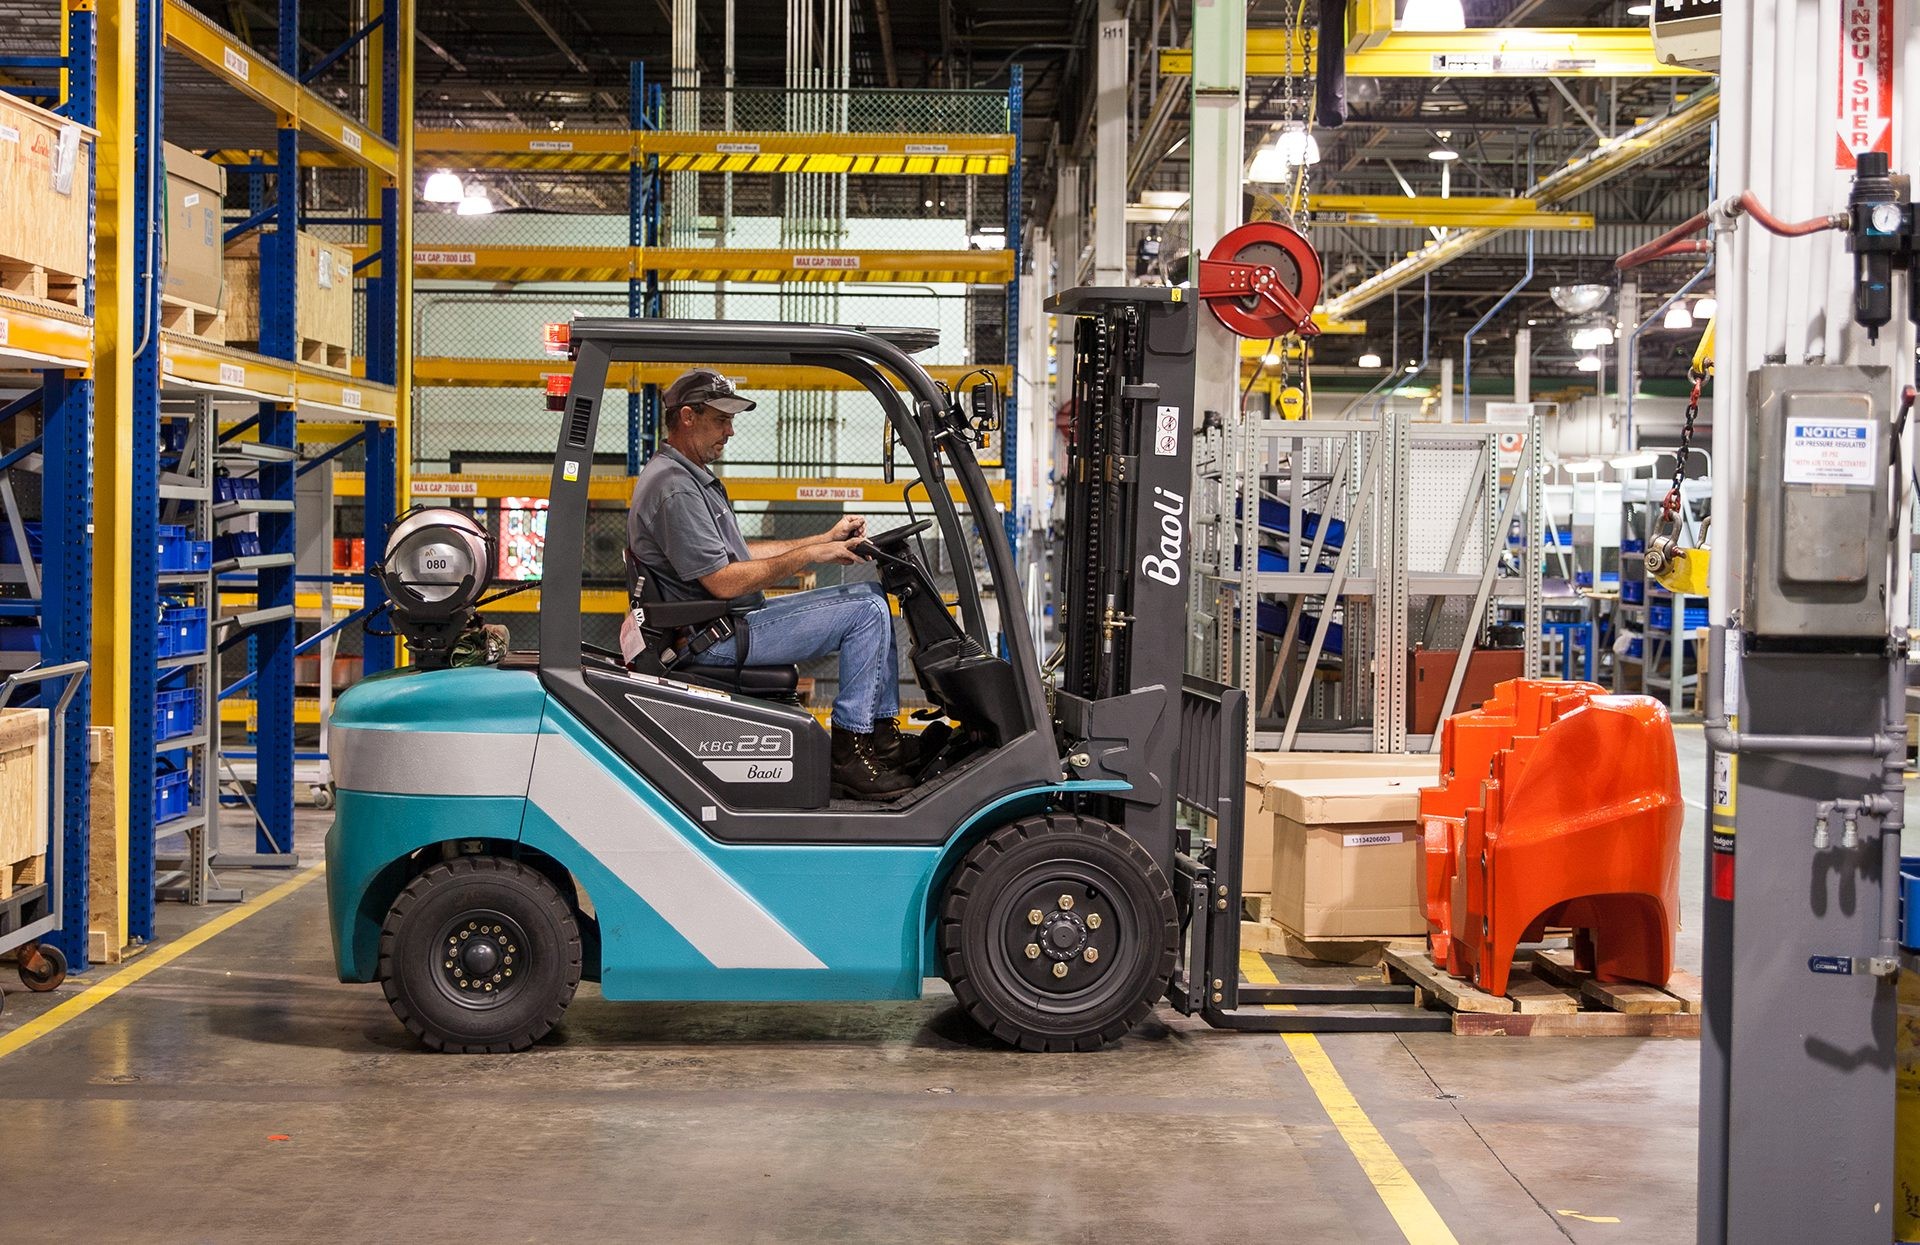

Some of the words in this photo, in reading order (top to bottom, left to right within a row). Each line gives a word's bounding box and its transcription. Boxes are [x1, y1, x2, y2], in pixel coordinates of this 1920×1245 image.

[1103, 27, 1124, 39] H11
[1802, 427, 1857, 438] NOTICE
[1805, 440, 1833, 448] PRESSURE
[1141, 486, 1184, 586] Baoli
[426, 559, 447, 570] 080
[698, 740, 734, 752] KBG
[736, 735, 782, 752] 25
[747, 764, 783, 779] Baoli
